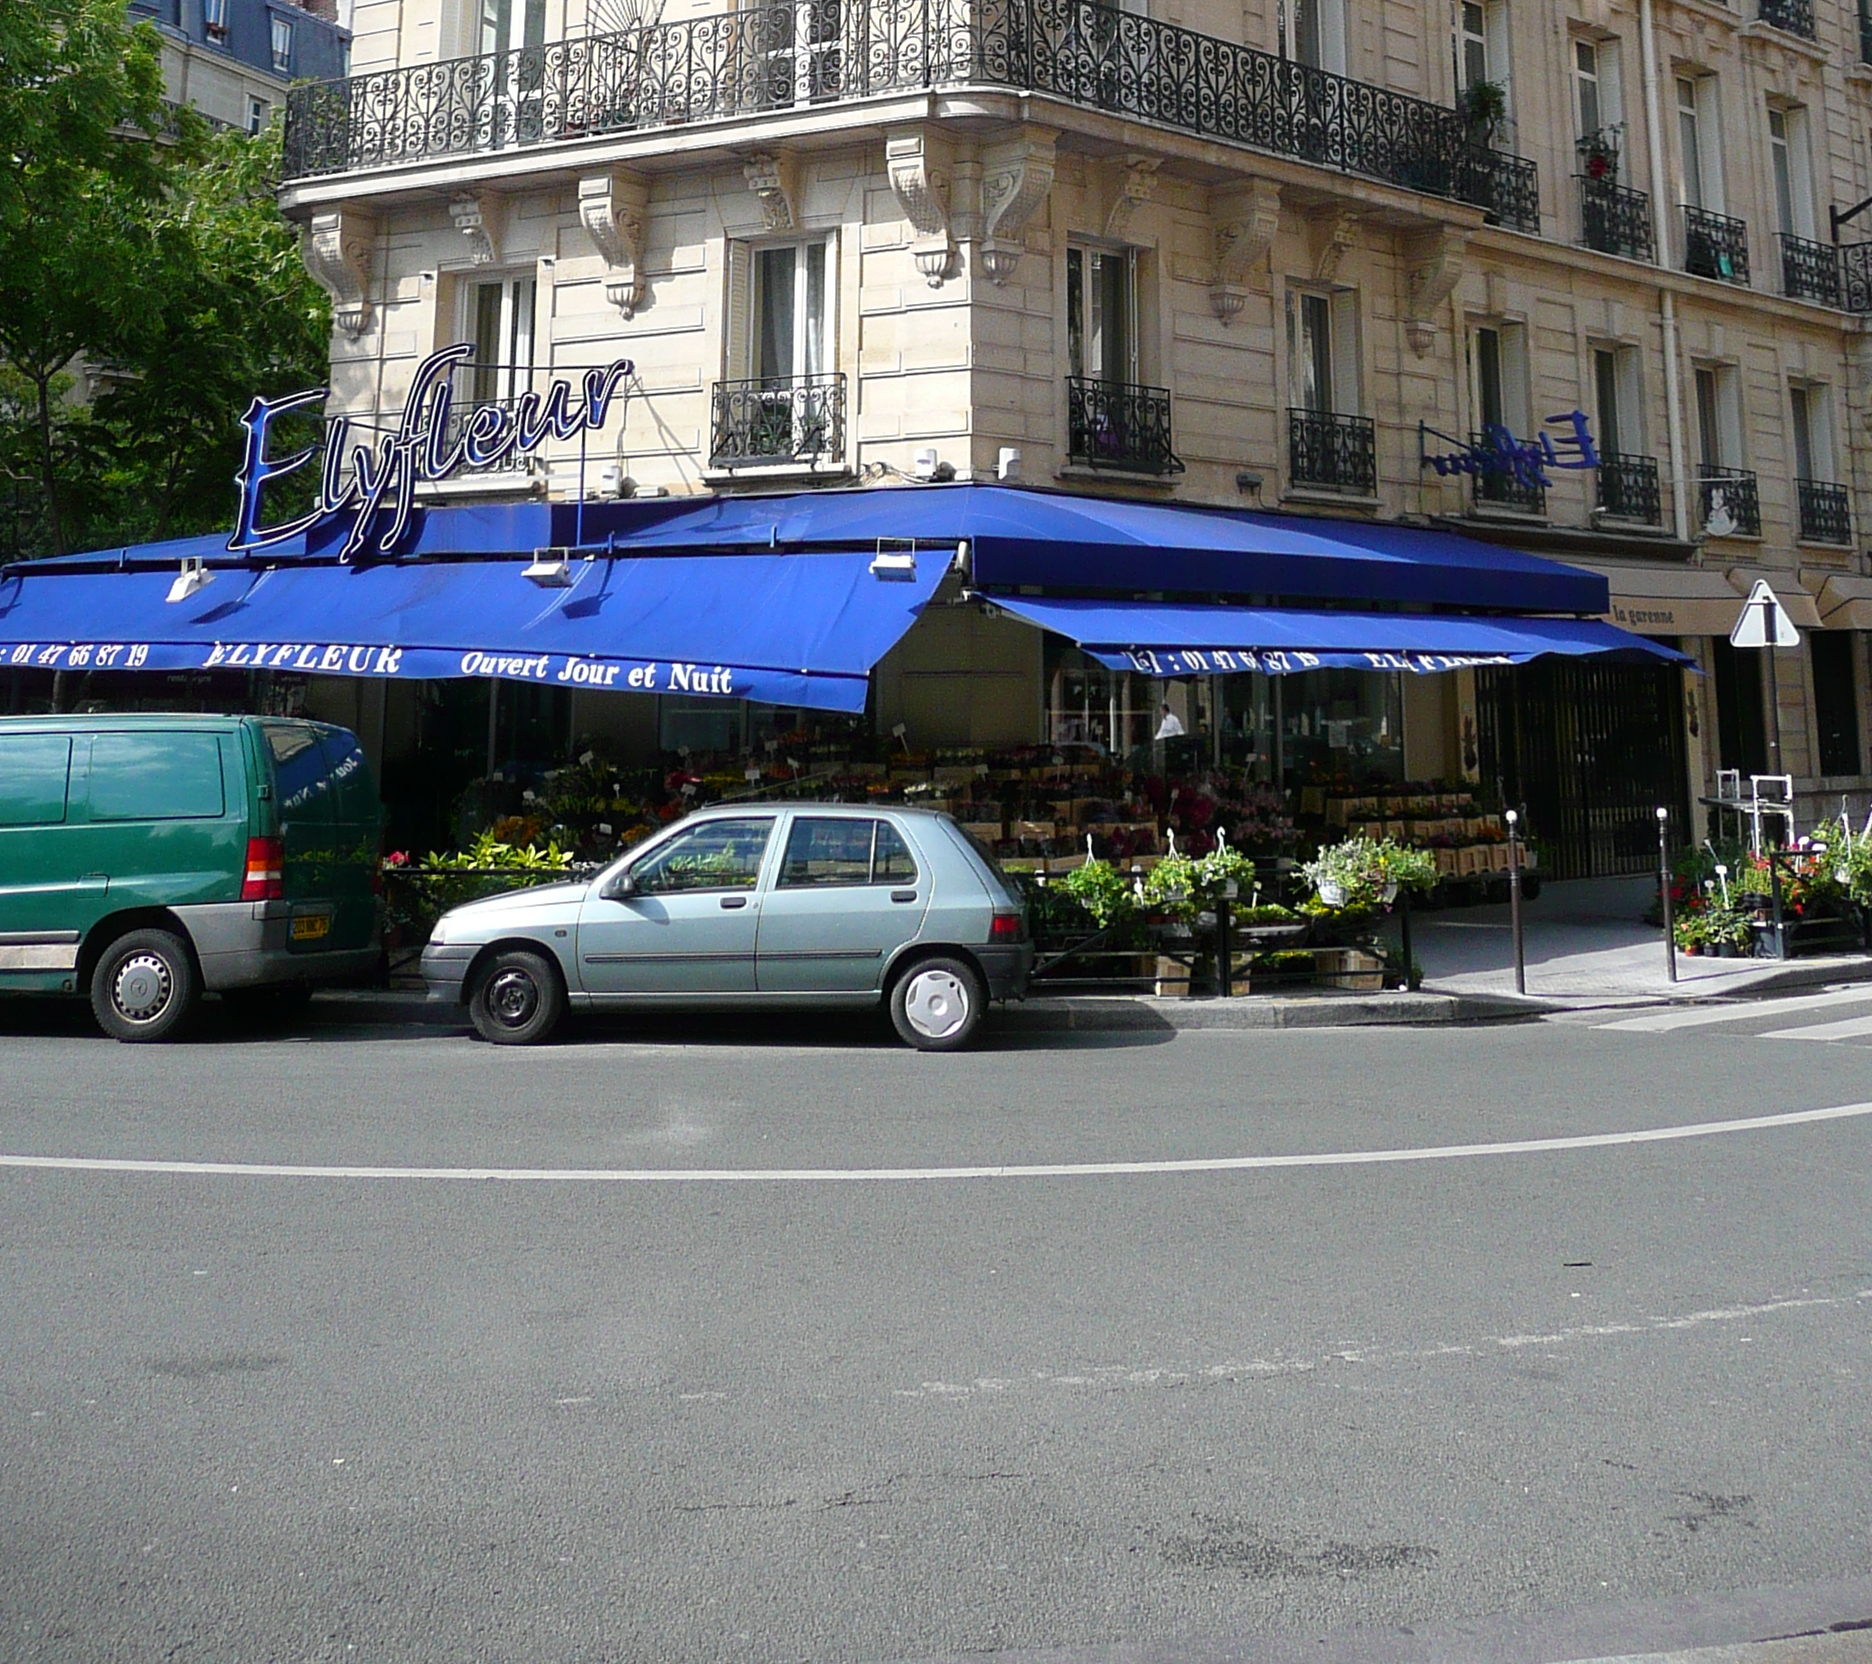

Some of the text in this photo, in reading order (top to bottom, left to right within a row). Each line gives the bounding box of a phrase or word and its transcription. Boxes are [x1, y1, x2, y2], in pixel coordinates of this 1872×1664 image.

[226, 342, 633, 564] Elyfleur
[1612, 604, 1675, 626] la garenne
[11, 644, 37, 664] 01
[37, 644, 68, 665] 47
[68, 645, 94, 667] 66
[95, 644, 124, 667] 87
[124, 644, 149, 667] 19
[202, 642, 403, 674] ELYFLEUR
[1181, 650, 1210, 671] 01
[1212, 650, 1237, 670] 47
[1262, 652, 1292, 671] 87
[461, 651, 733, 695] Ouvert Jour et Nuit
